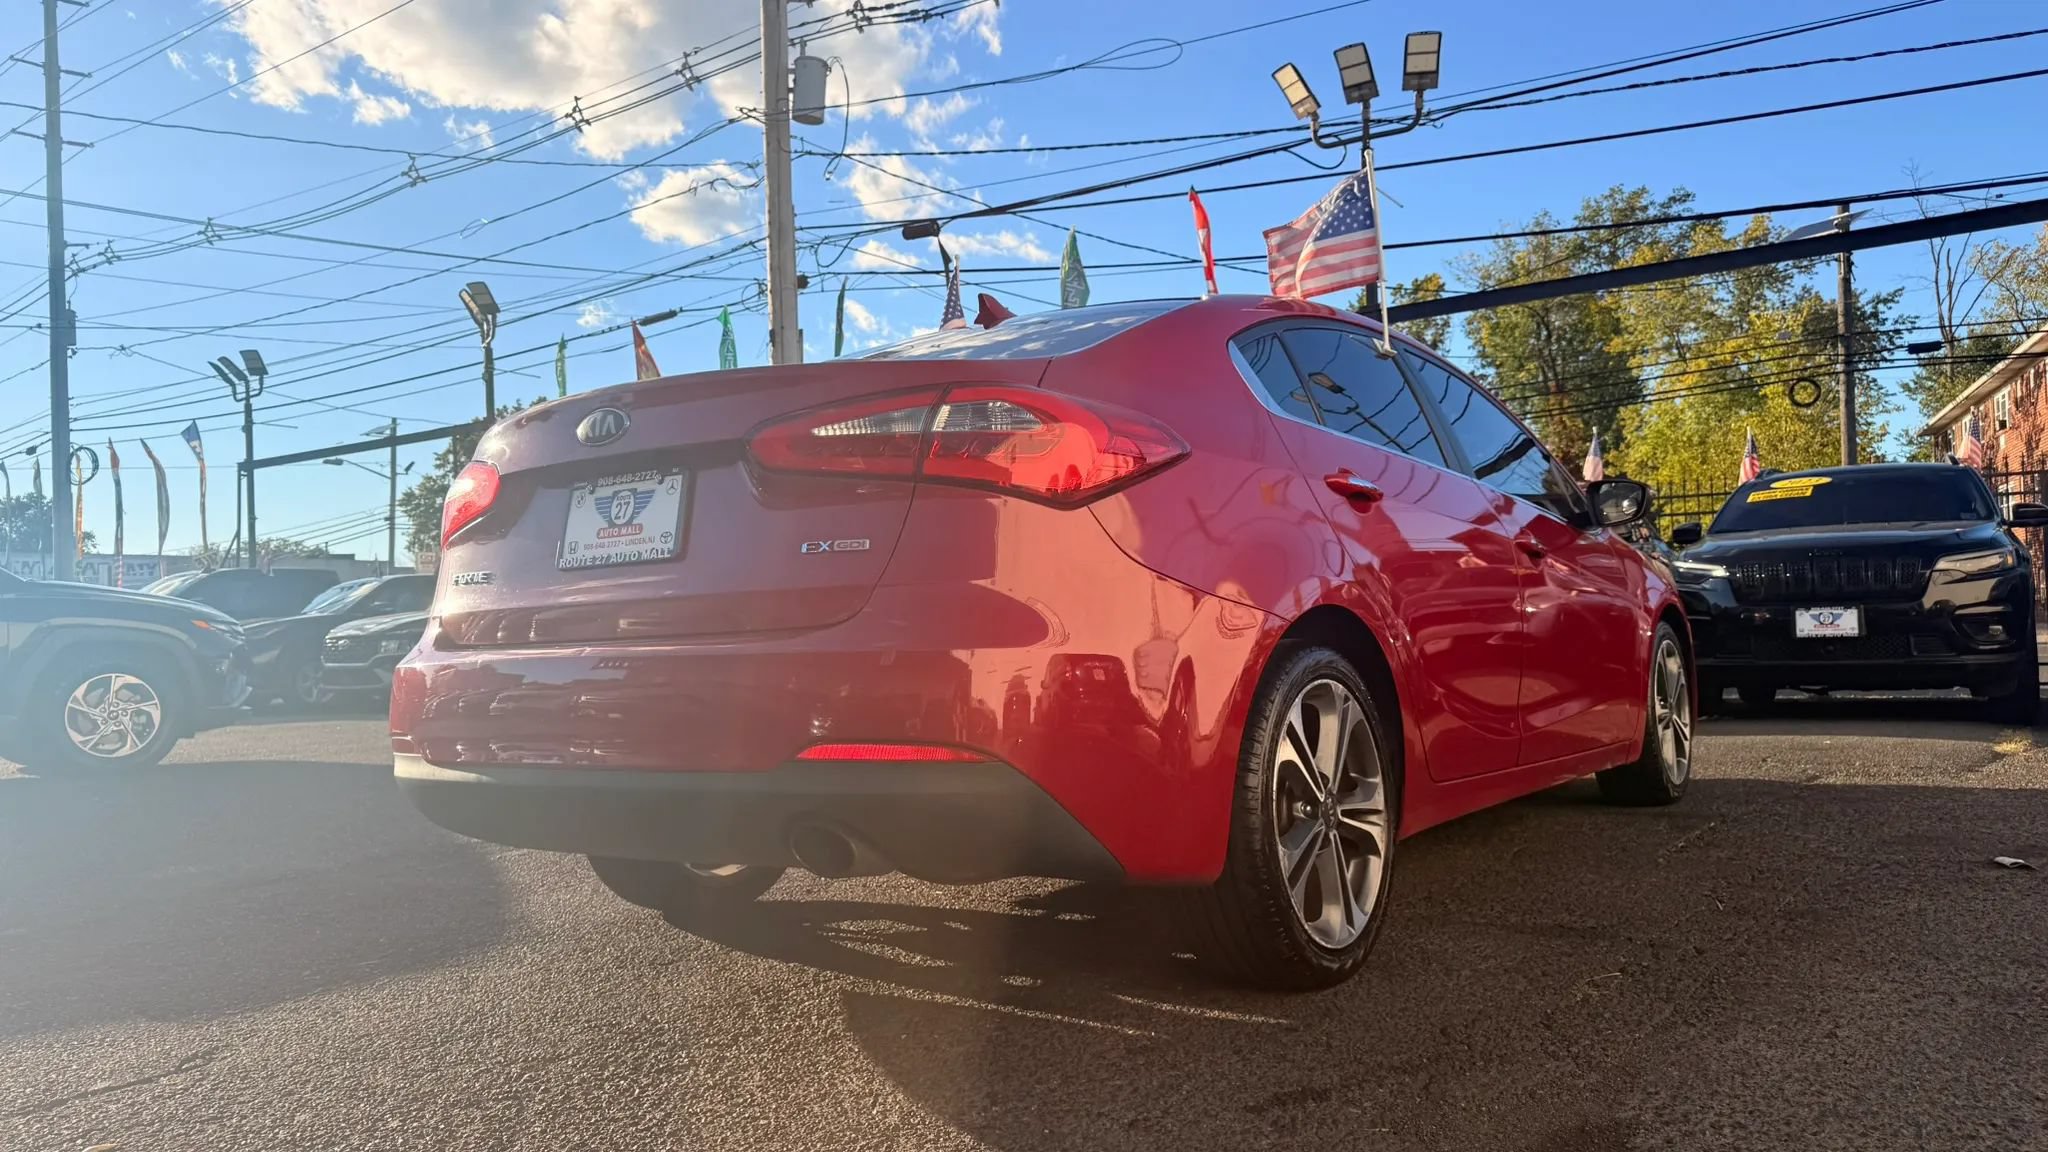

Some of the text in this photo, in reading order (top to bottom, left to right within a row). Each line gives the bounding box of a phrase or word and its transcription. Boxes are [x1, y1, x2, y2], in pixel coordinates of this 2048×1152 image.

[614, 501, 631, 520] 27
[598, 525, 640, 538] AUTO MALL
[801, 539, 869, 553] EX GDI
[558, 547, 671, 569] ROUTE 27 AUTO MALL
